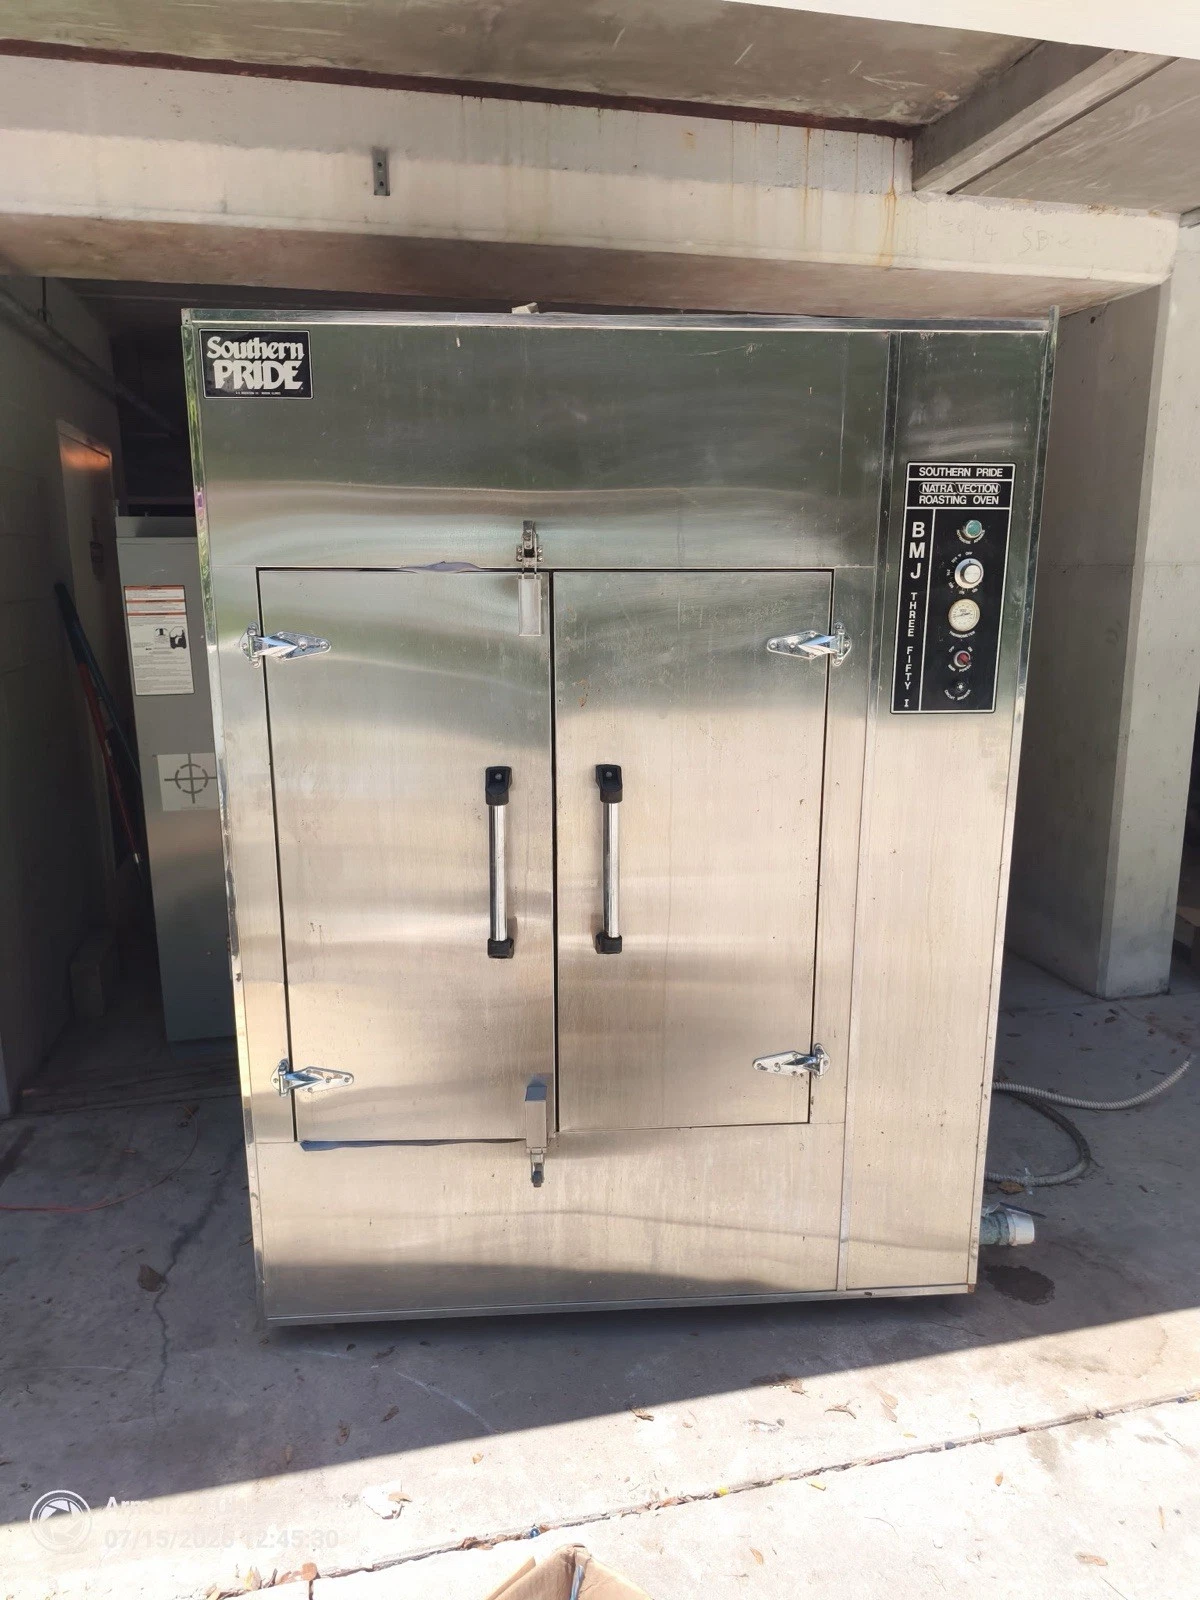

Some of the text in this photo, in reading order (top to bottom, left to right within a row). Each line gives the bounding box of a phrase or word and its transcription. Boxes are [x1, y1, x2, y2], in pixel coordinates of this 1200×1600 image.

[206, 336, 305, 360] Southern
[212, 359, 304, 390] PRIDE
[918, 466, 1004, 477] SOUTHERN PRIDE
[918, 495, 999, 505] ROASTING OVEN
[921, 483, 999, 493] NATRA VECTION
[907, 592, 918, 637] THREE
[904, 646, 914, 690] FIFTY
